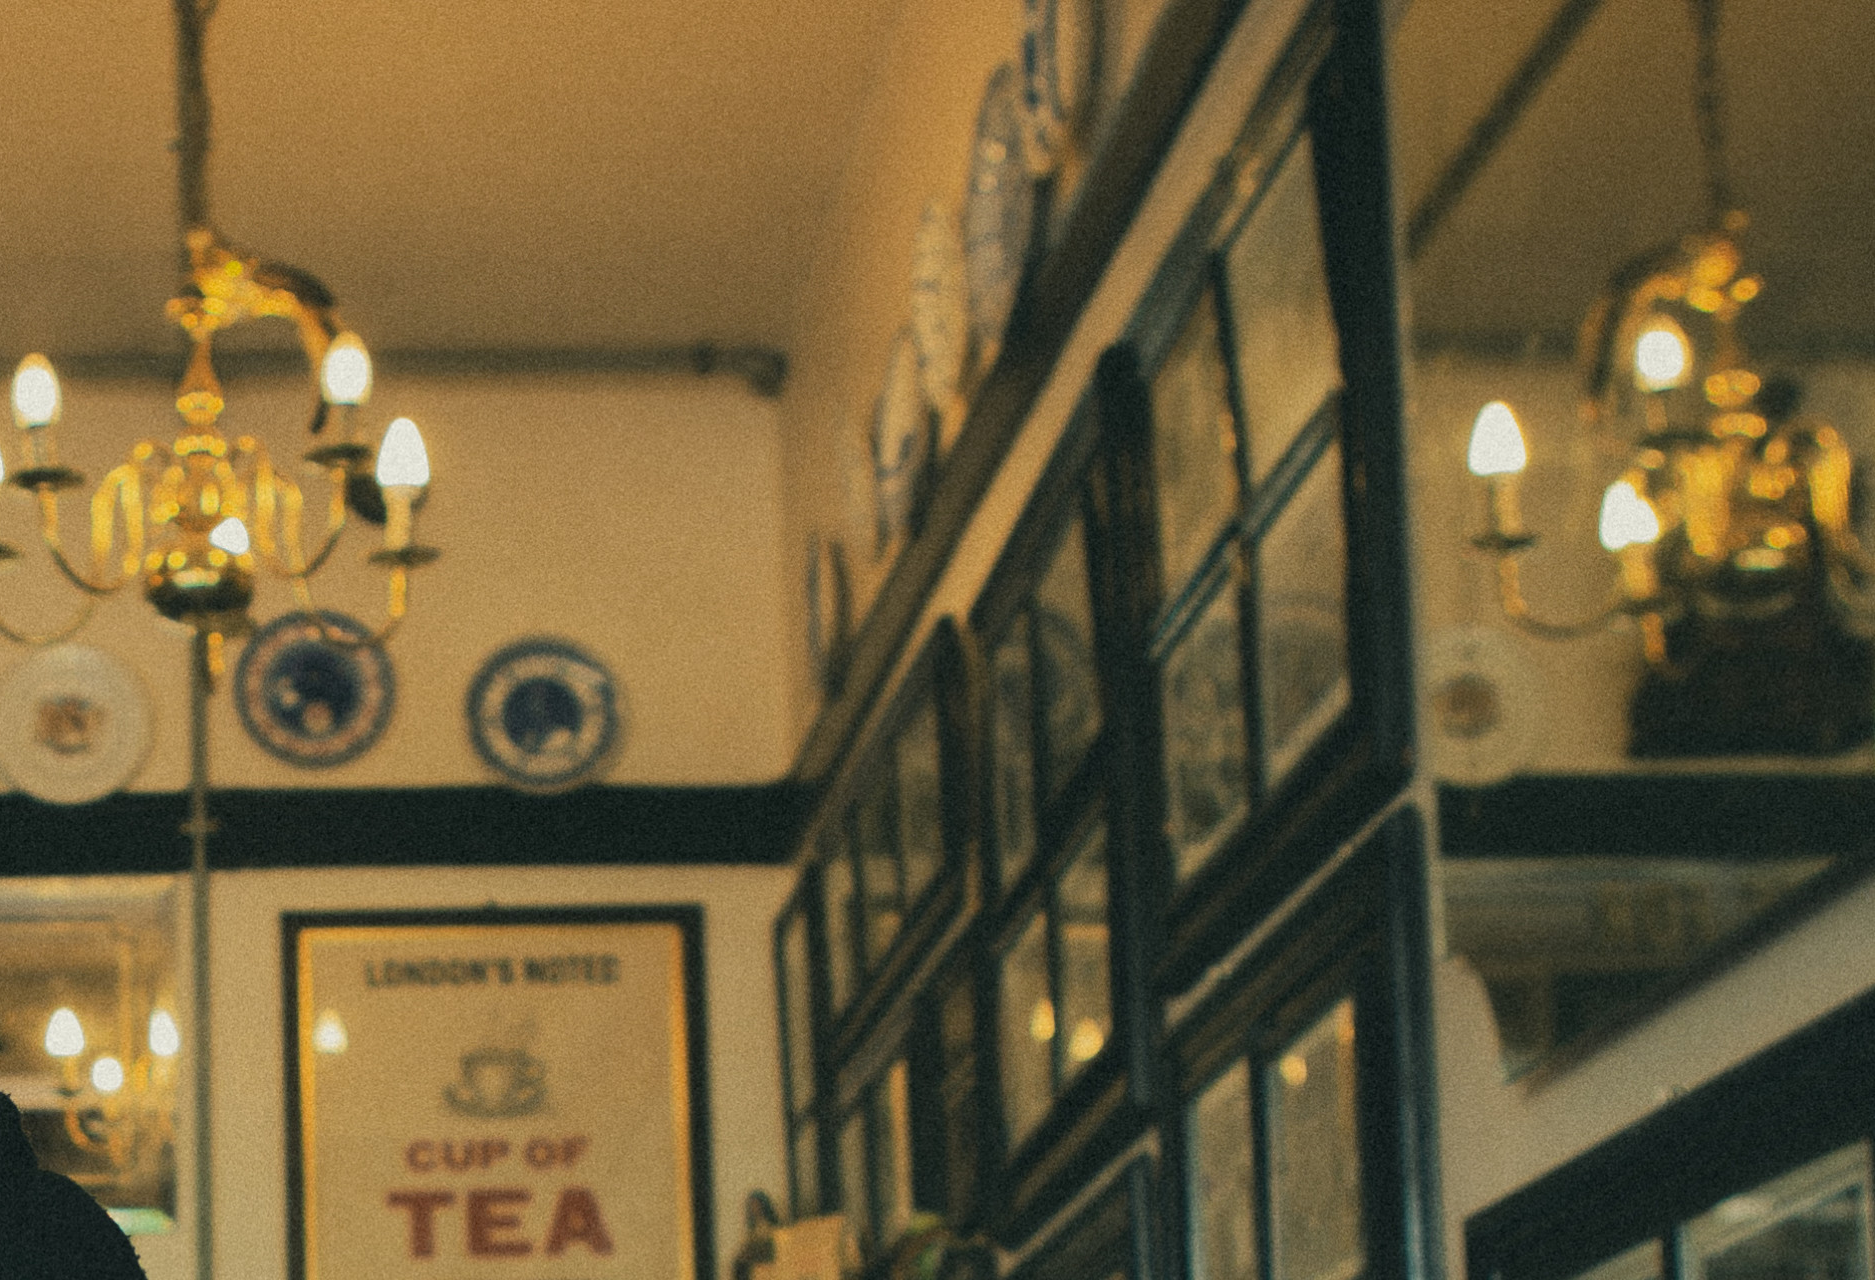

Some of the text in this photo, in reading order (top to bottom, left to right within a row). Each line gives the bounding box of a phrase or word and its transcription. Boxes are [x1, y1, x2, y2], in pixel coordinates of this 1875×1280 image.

[365, 956, 514, 988] LONDON'S
[404, 1134, 589, 1172] CUP OF
[387, 1186, 615, 1259] TEA
